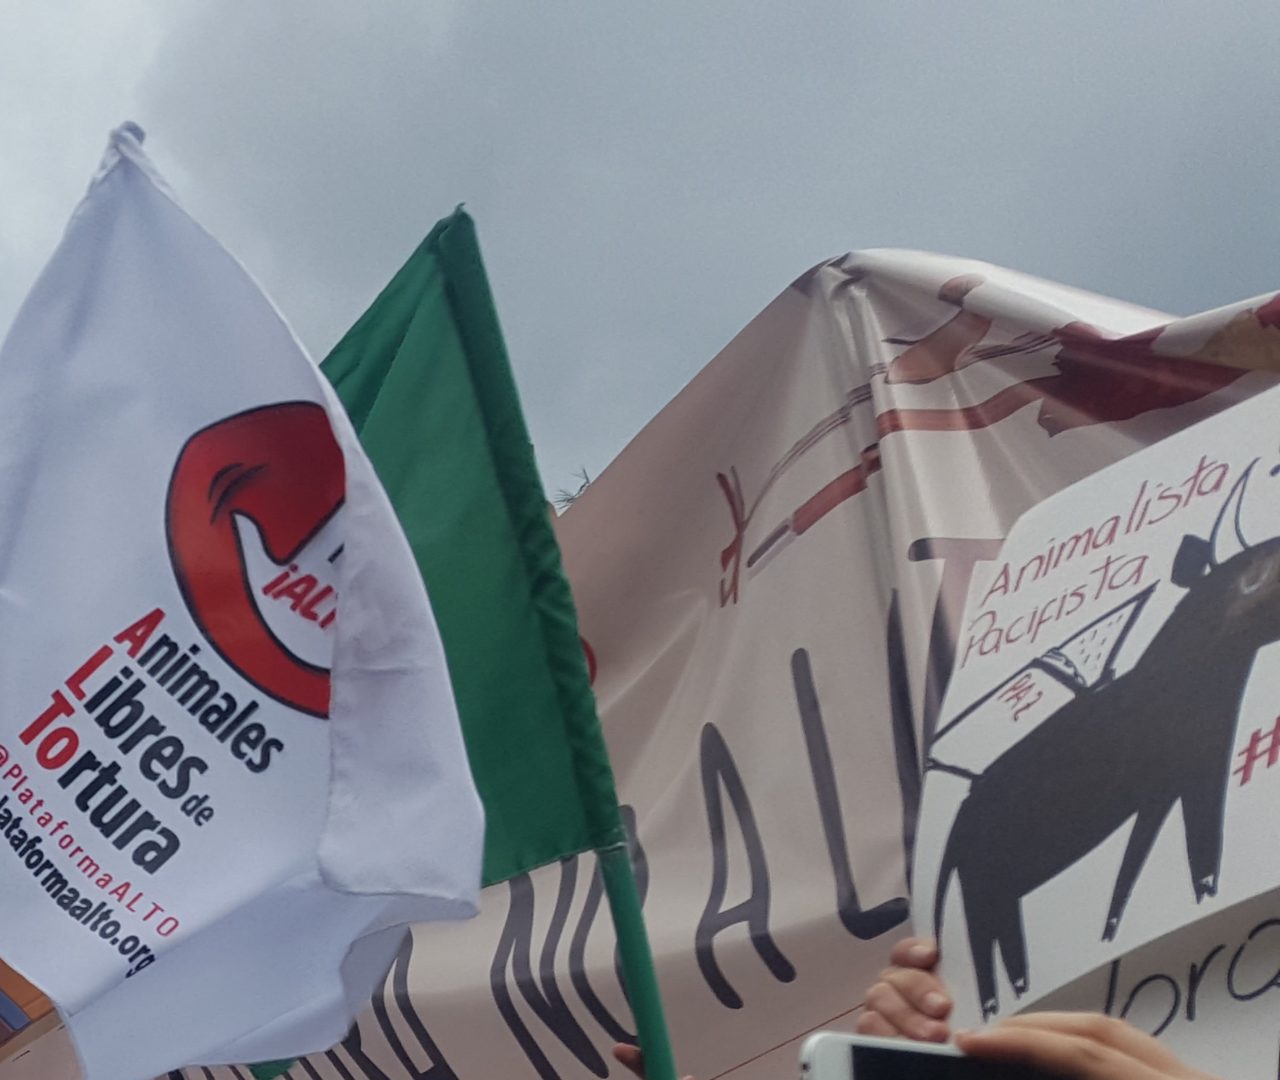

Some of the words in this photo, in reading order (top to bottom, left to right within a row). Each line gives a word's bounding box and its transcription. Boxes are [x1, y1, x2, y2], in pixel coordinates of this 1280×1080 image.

[960, 555, 1149, 669] Pacifista
[979, 455, 1229, 608] Animalista
[64, 645, 209, 799] Libres
[180, 793, 215, 827] de
[112, 607, 285, 774] Animales
[18, 690, 181, 875] Tortura
[696, 722, 797, 1010] A
